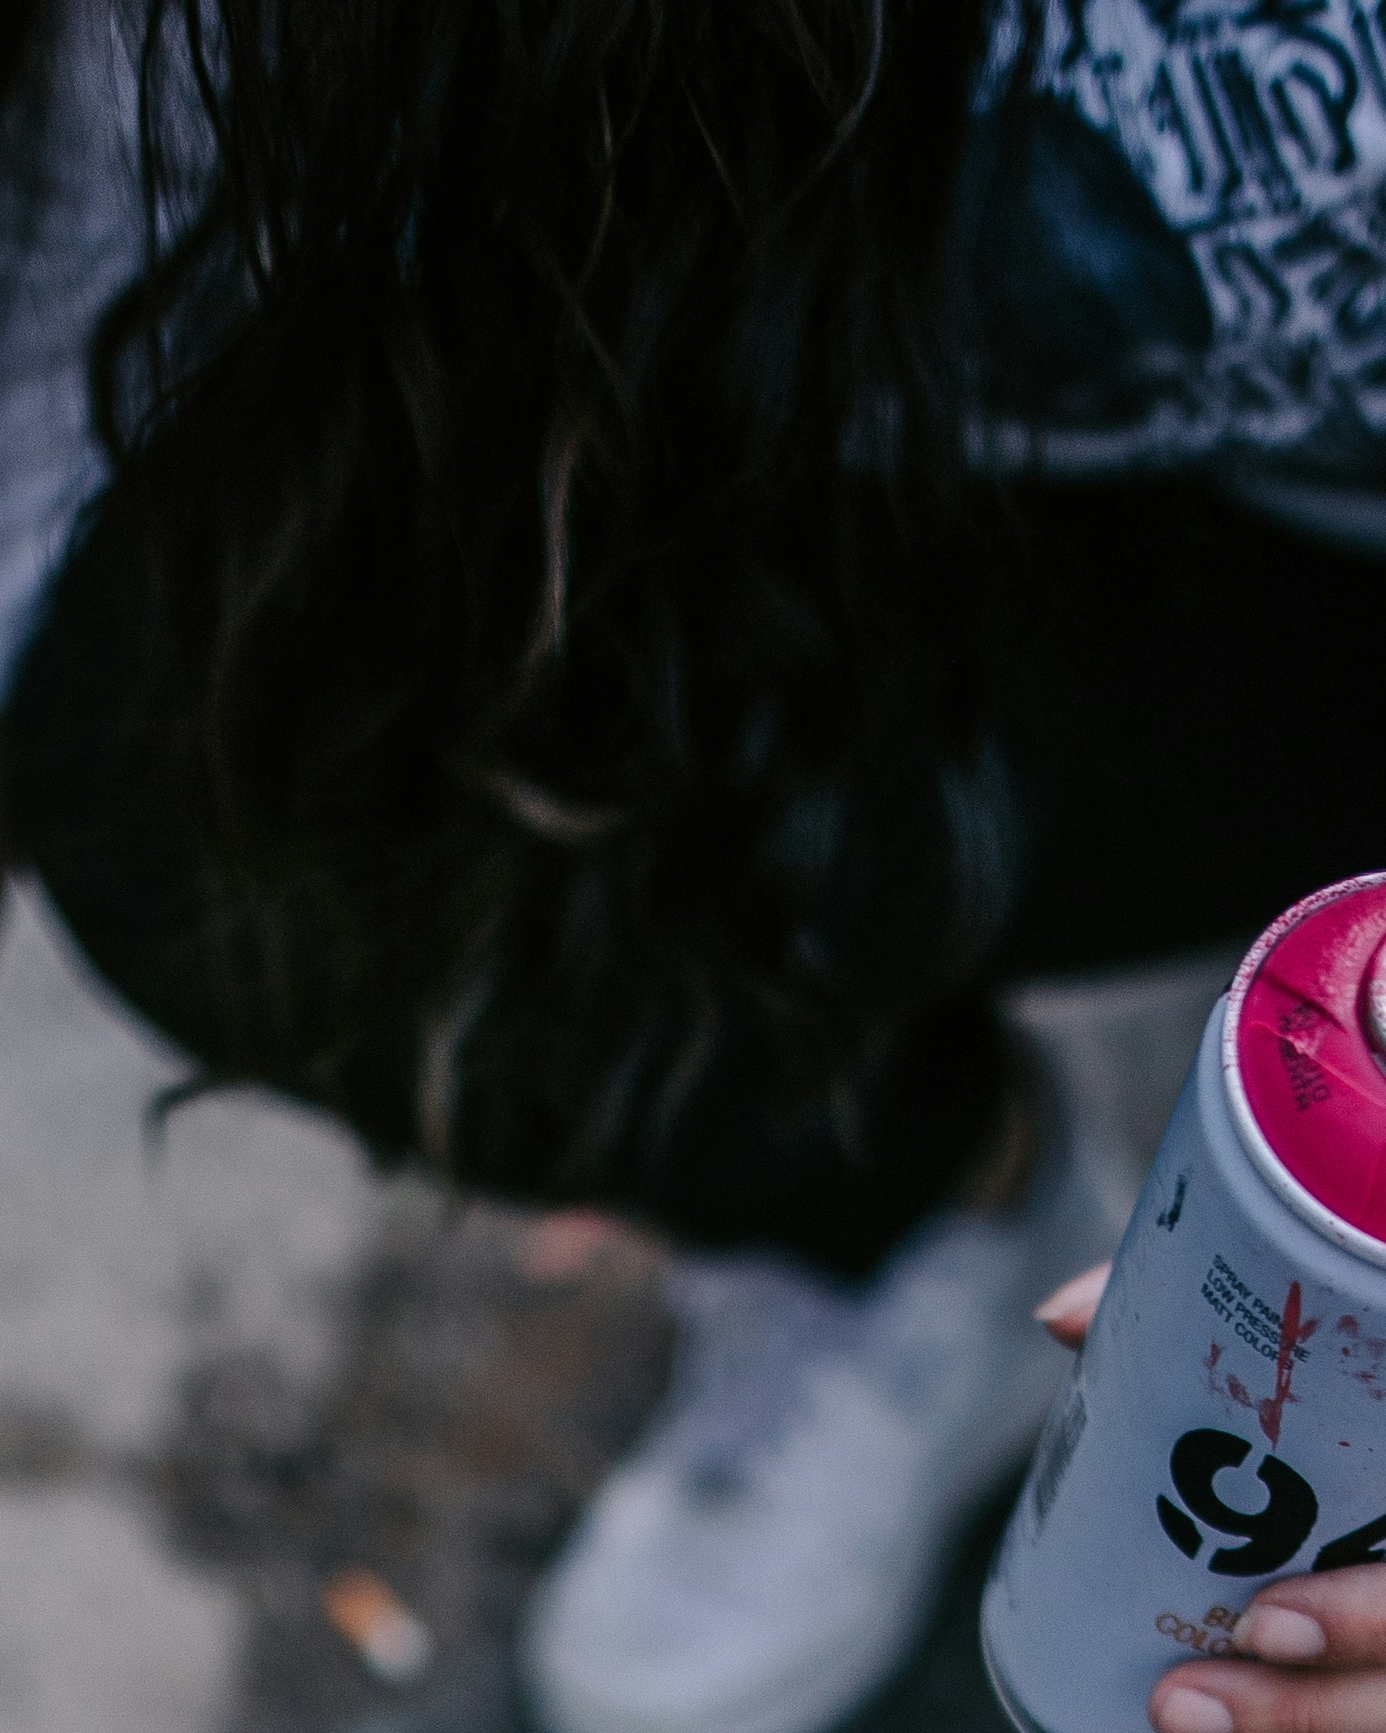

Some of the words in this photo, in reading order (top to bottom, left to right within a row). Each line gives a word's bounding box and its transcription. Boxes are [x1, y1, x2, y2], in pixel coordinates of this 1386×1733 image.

[1206, 1268, 1235, 1304] LOW
[1213, 1253, 1253, 1300] SPRAY
[1201, 1282, 1234, 1323] MATT
